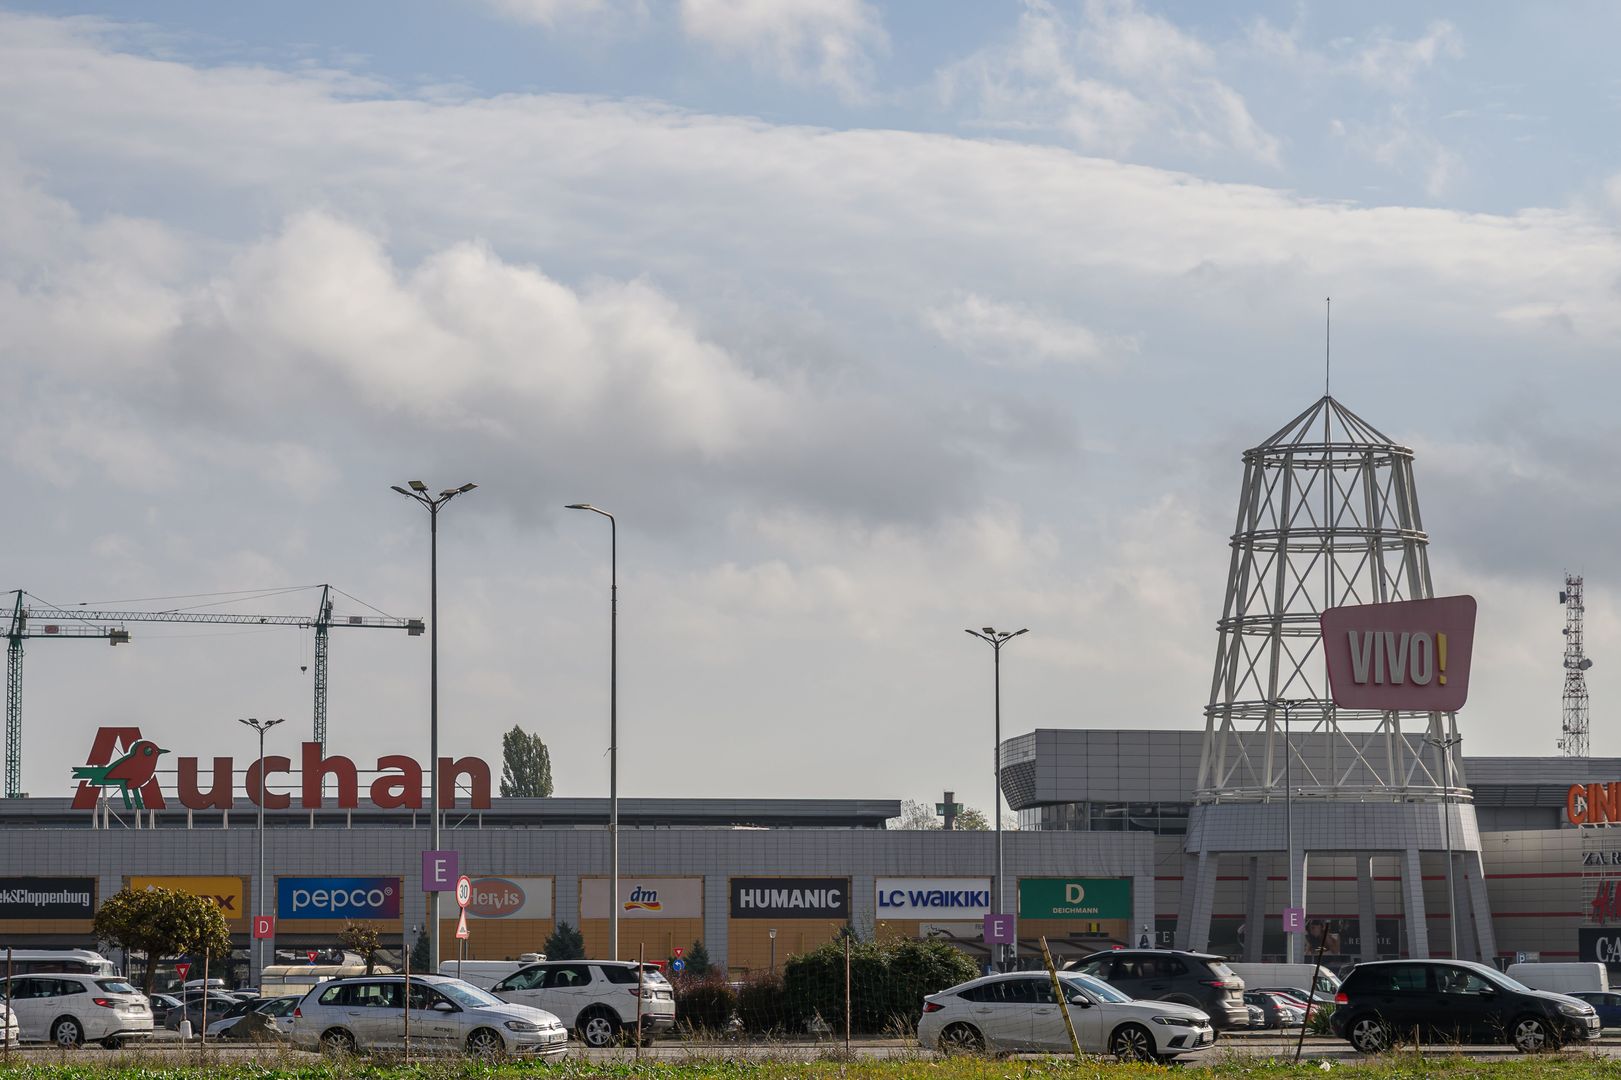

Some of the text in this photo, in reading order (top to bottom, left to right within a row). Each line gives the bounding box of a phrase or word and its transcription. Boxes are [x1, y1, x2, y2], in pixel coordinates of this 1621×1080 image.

[1347, 630, 1448, 686] VIVO!
[71, 726, 492, 810] Auchan
[1567, 782, 1621, 825] CIN
[434, 859, 448, 882] E
[459, 884, 468, 899] 30
[630, 886, 657, 902] dm
[739, 888, 842, 908] HUMANIC
[879, 890, 905, 907] LC
[1065, 883, 1085, 904] D
[259, 920, 269, 934] D
[994, 920, 1004, 937] E
[1291, 913, 1298, 927] E
